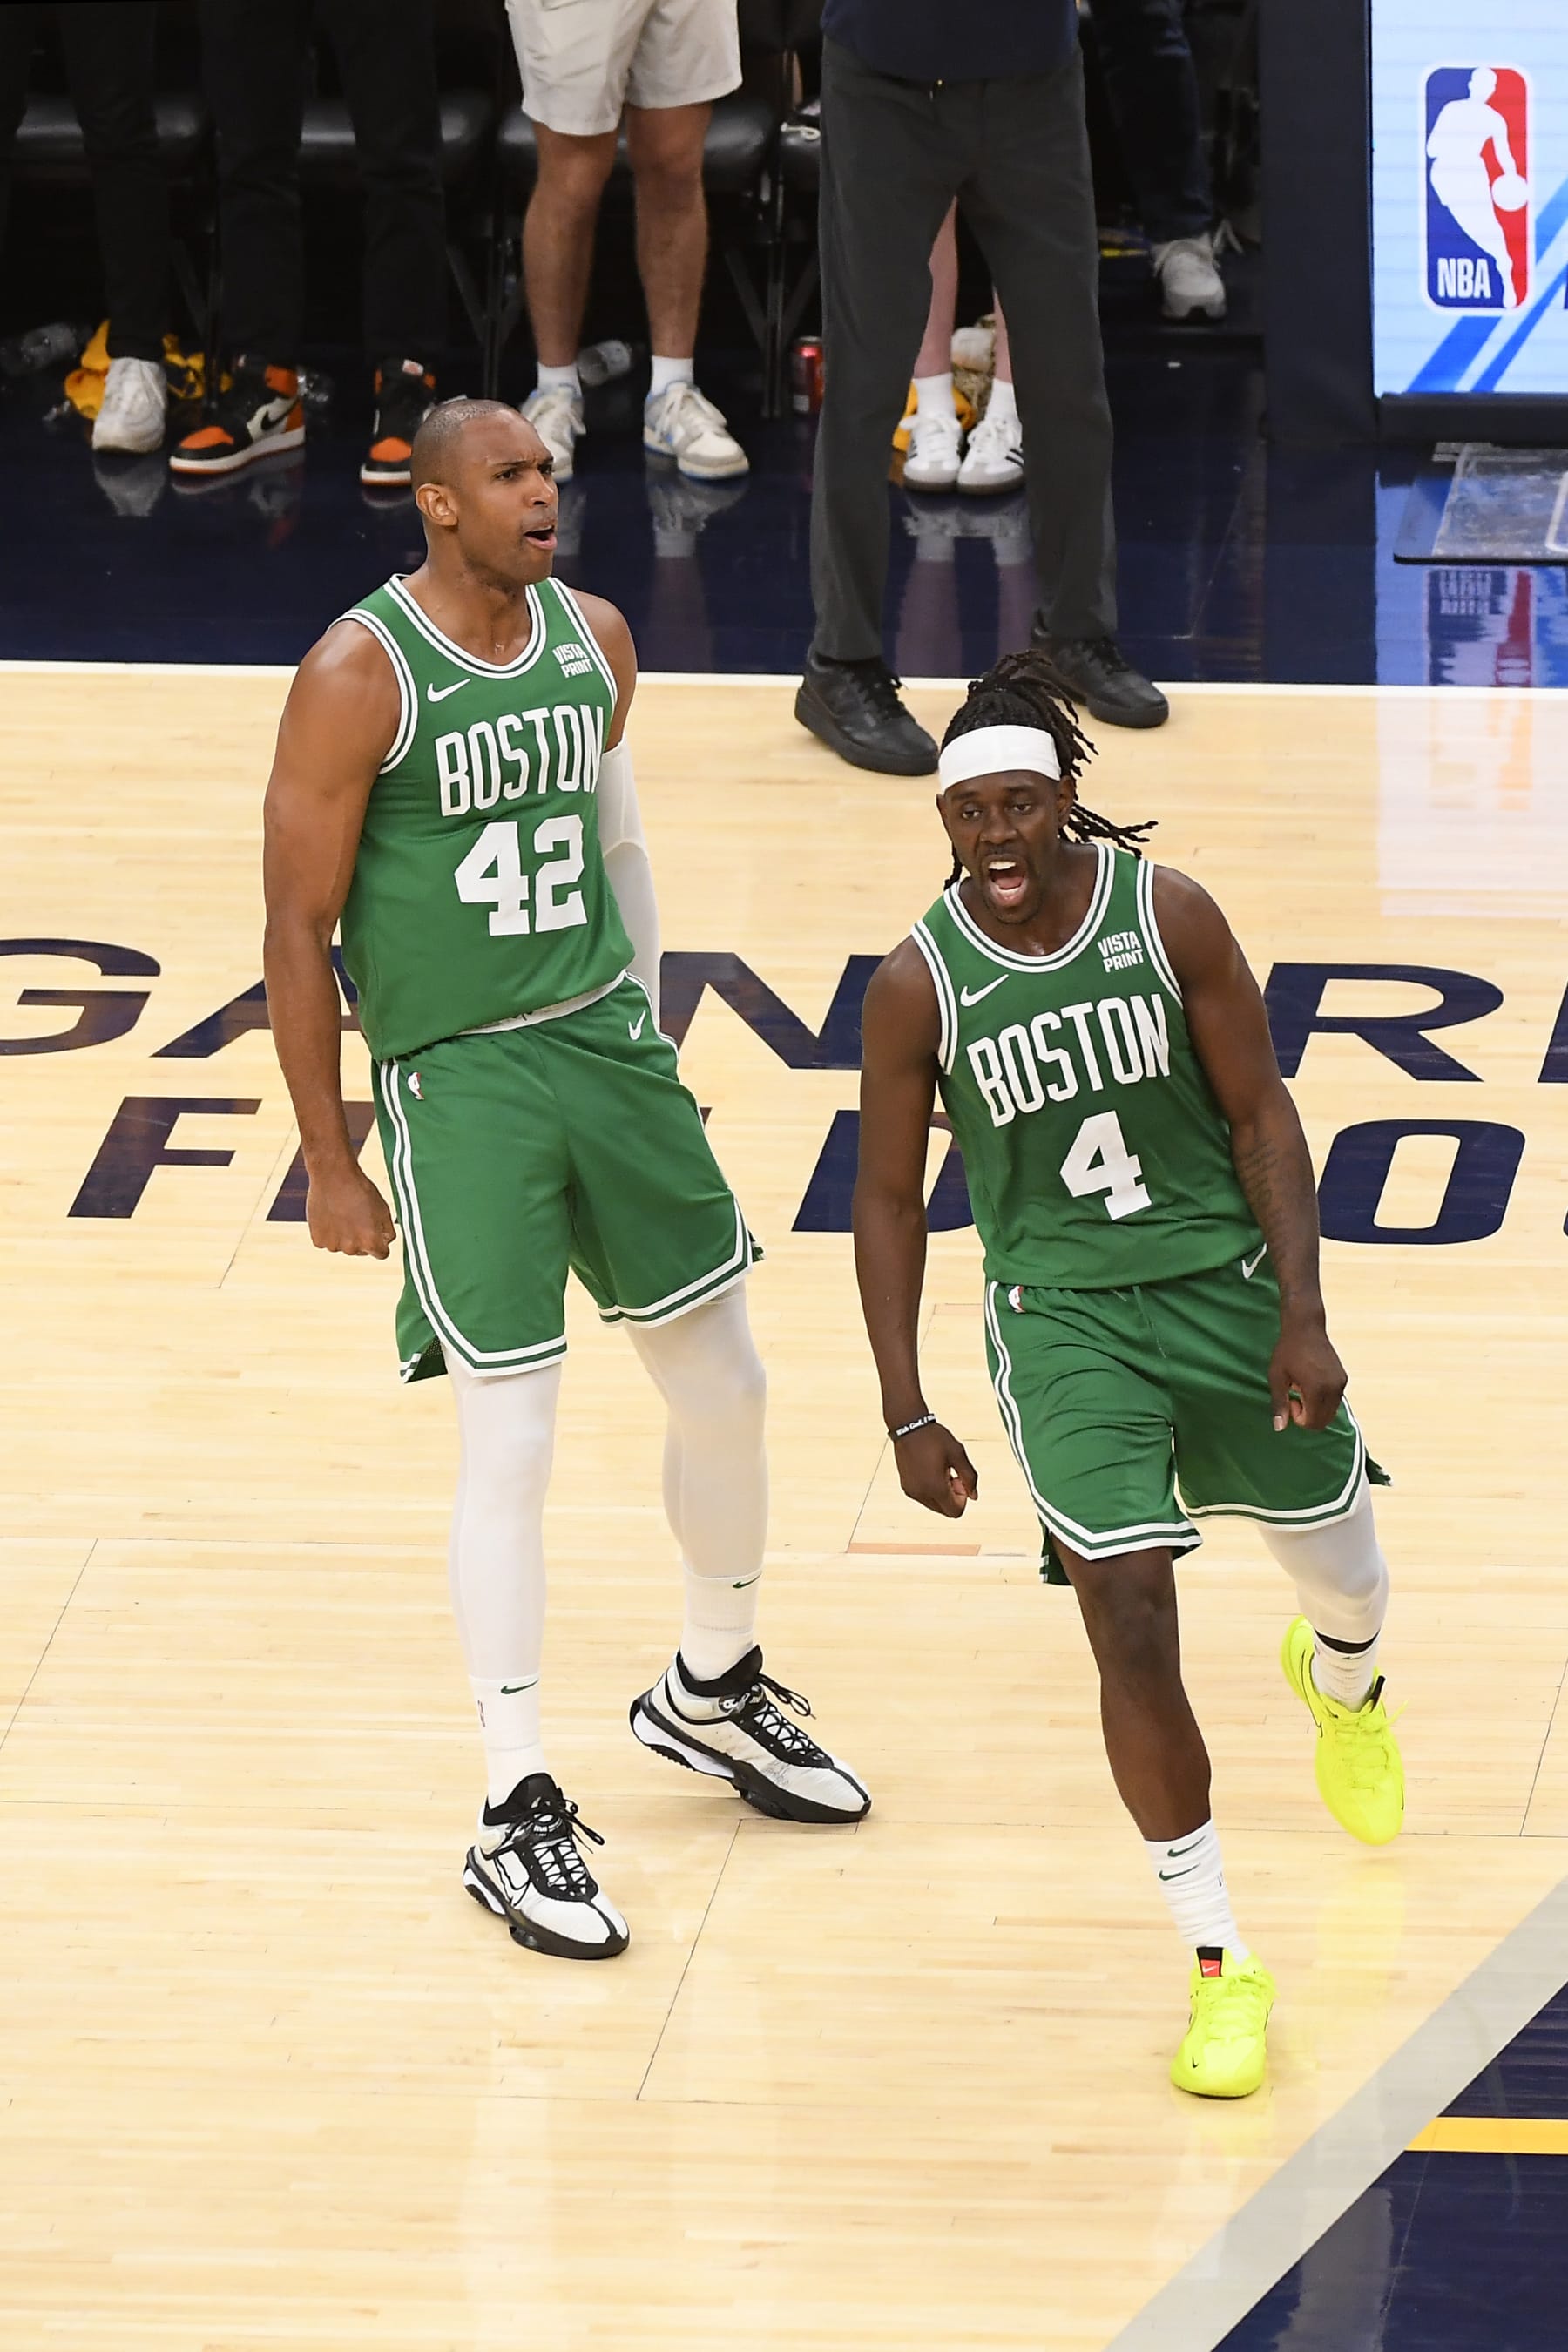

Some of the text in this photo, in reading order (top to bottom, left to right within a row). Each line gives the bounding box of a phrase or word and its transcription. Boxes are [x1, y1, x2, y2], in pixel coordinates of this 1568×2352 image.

[1437, 258, 1491, 298] NBA
[552, 643, 588, 664] VISTA
[560, 659, 593, 678] PRINT
[435, 704, 604, 817] BOSTON
[454, 814, 588, 936] 42
[1098, 930, 1141, 958] VISTA
[1103, 949, 1144, 973] PRINT
[966, 993, 1170, 1128] BOSTON
[1059, 1110, 1152, 1220] 4
